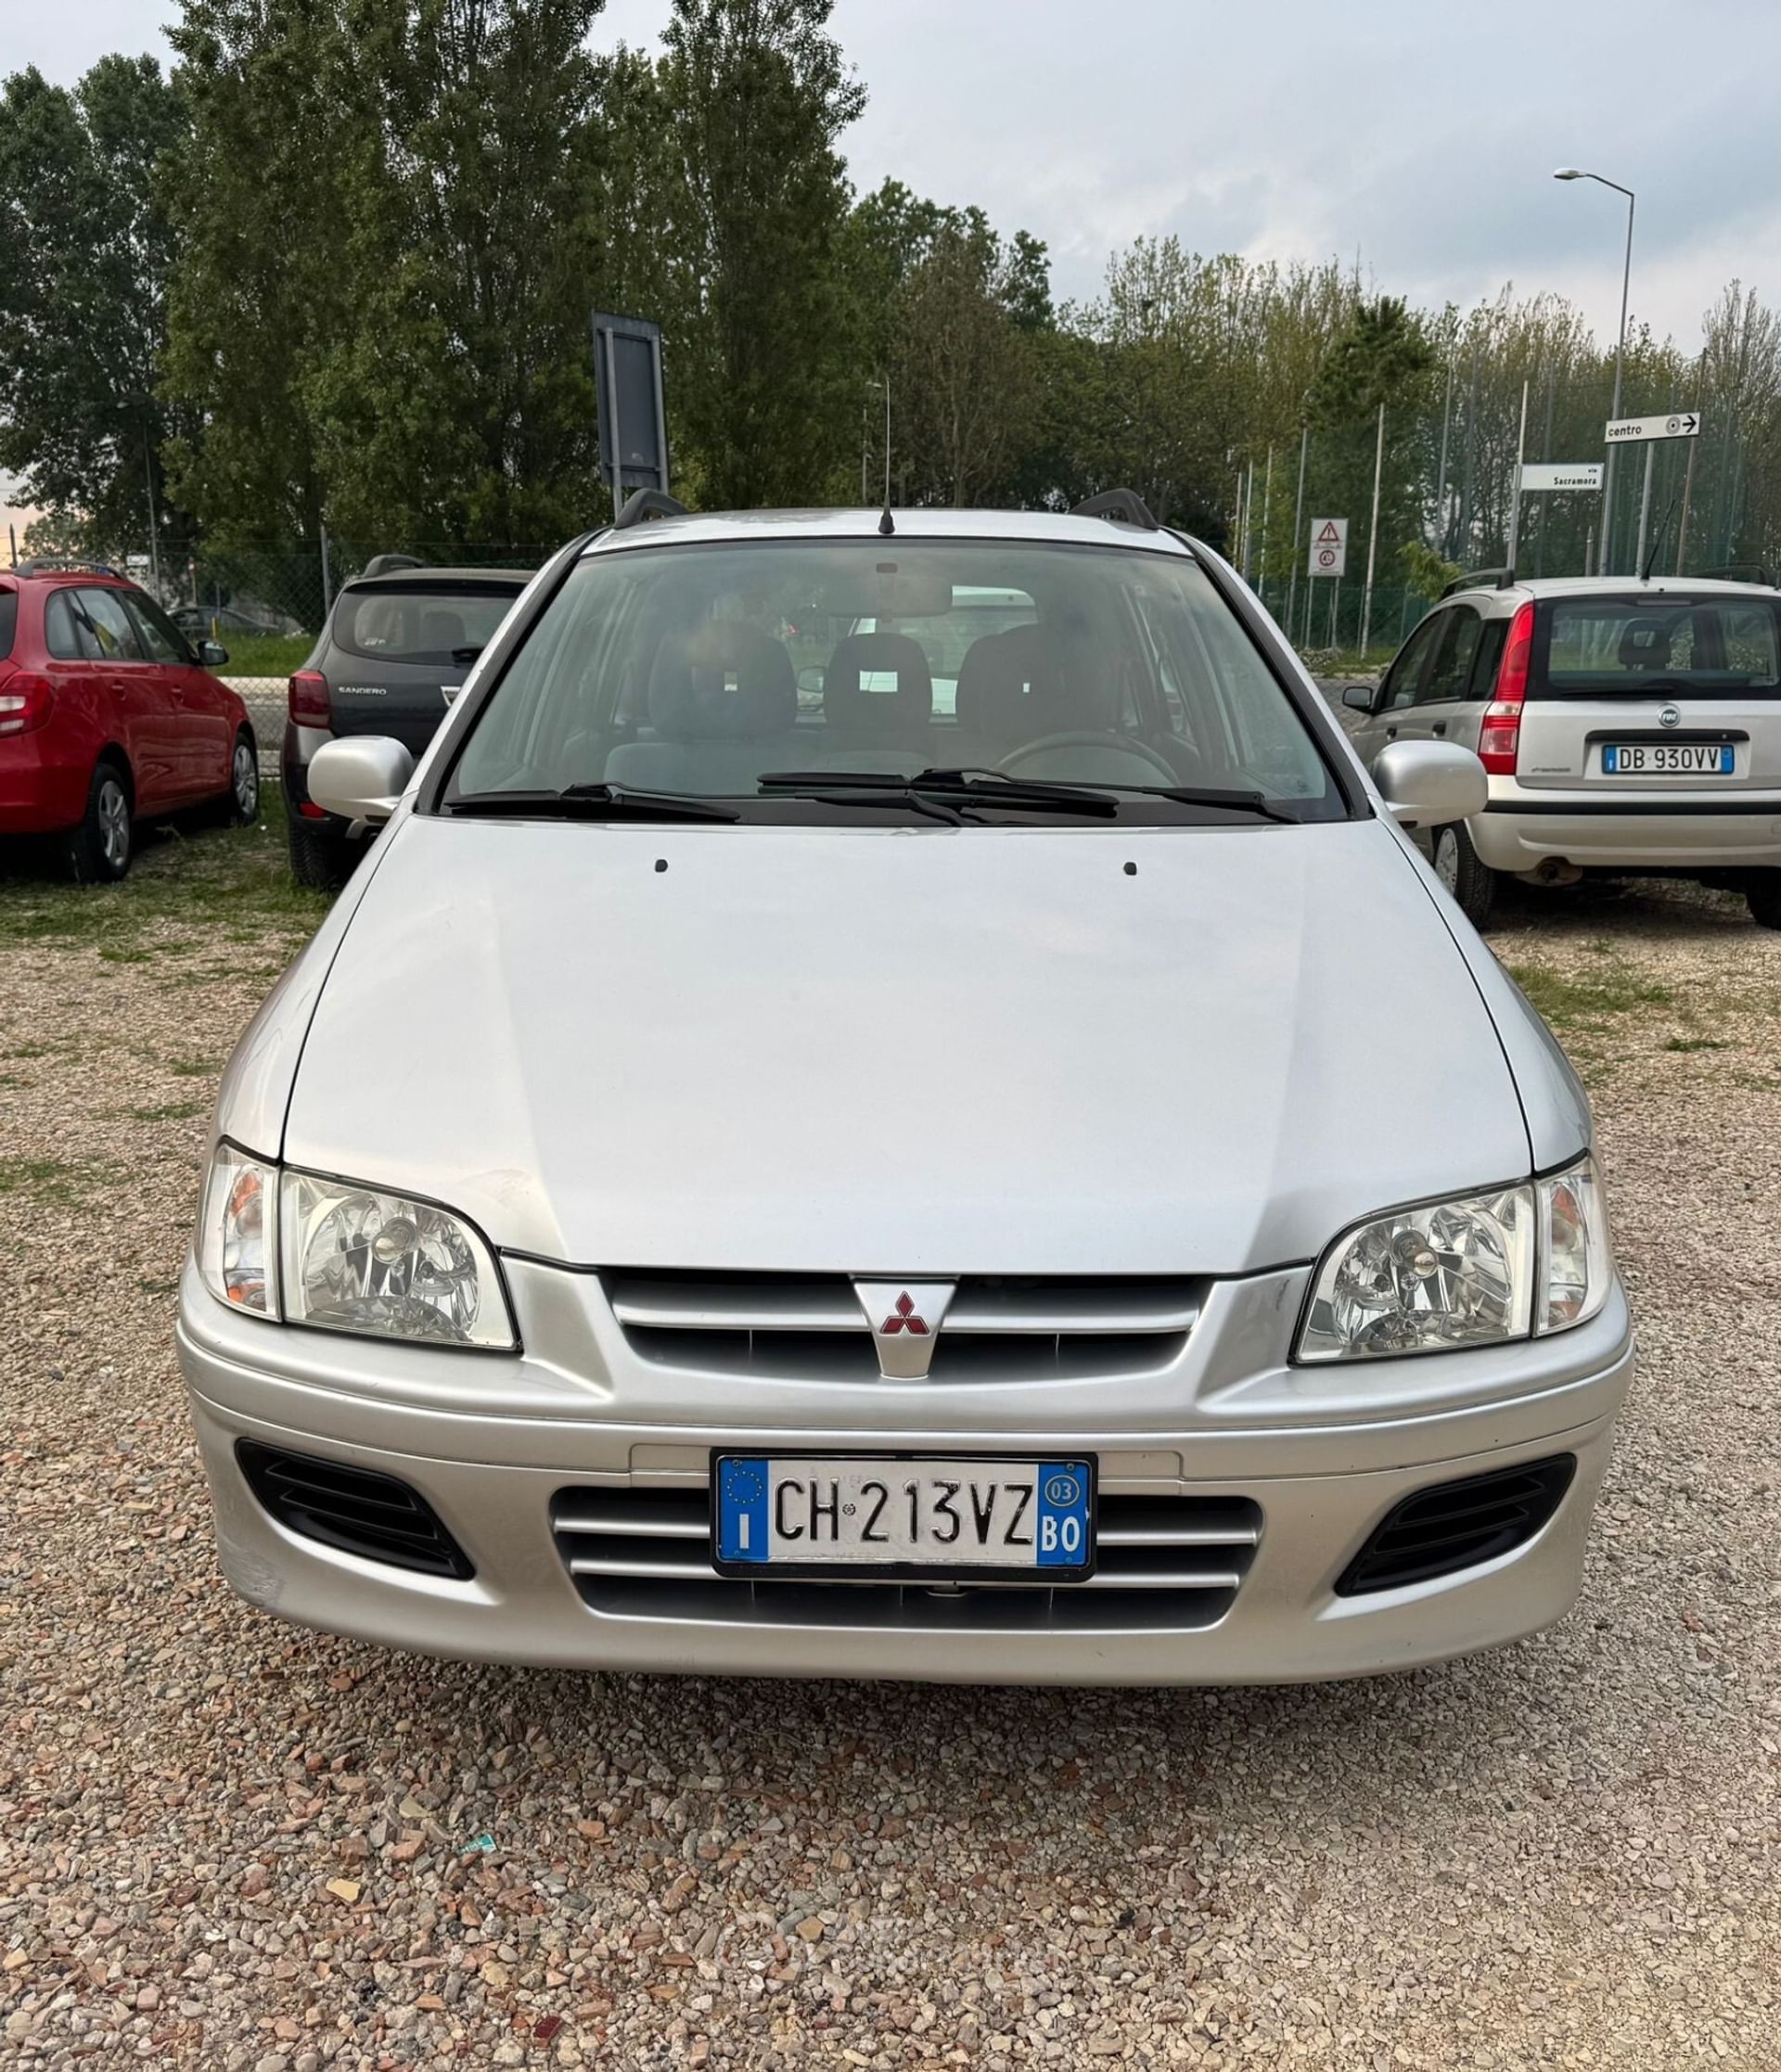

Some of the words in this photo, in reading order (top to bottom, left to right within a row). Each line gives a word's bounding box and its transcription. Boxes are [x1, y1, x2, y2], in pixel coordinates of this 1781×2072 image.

[1608, 425, 1642, 437] centro
[1554, 477, 1597, 485] Sacramora
[338, 686, 387, 696] SANDERO
[1620, 748, 1645, 769] DB
[1654, 748, 1718, 769] 930VV
[1050, 1482, 1072, 1500] 03
[775, 1477, 839, 1541] CH
[860, 1478, 1033, 1545] 213VZ
[739, 1514, 750, 1549] I
[1041, 1516, 1081, 1553] BO
